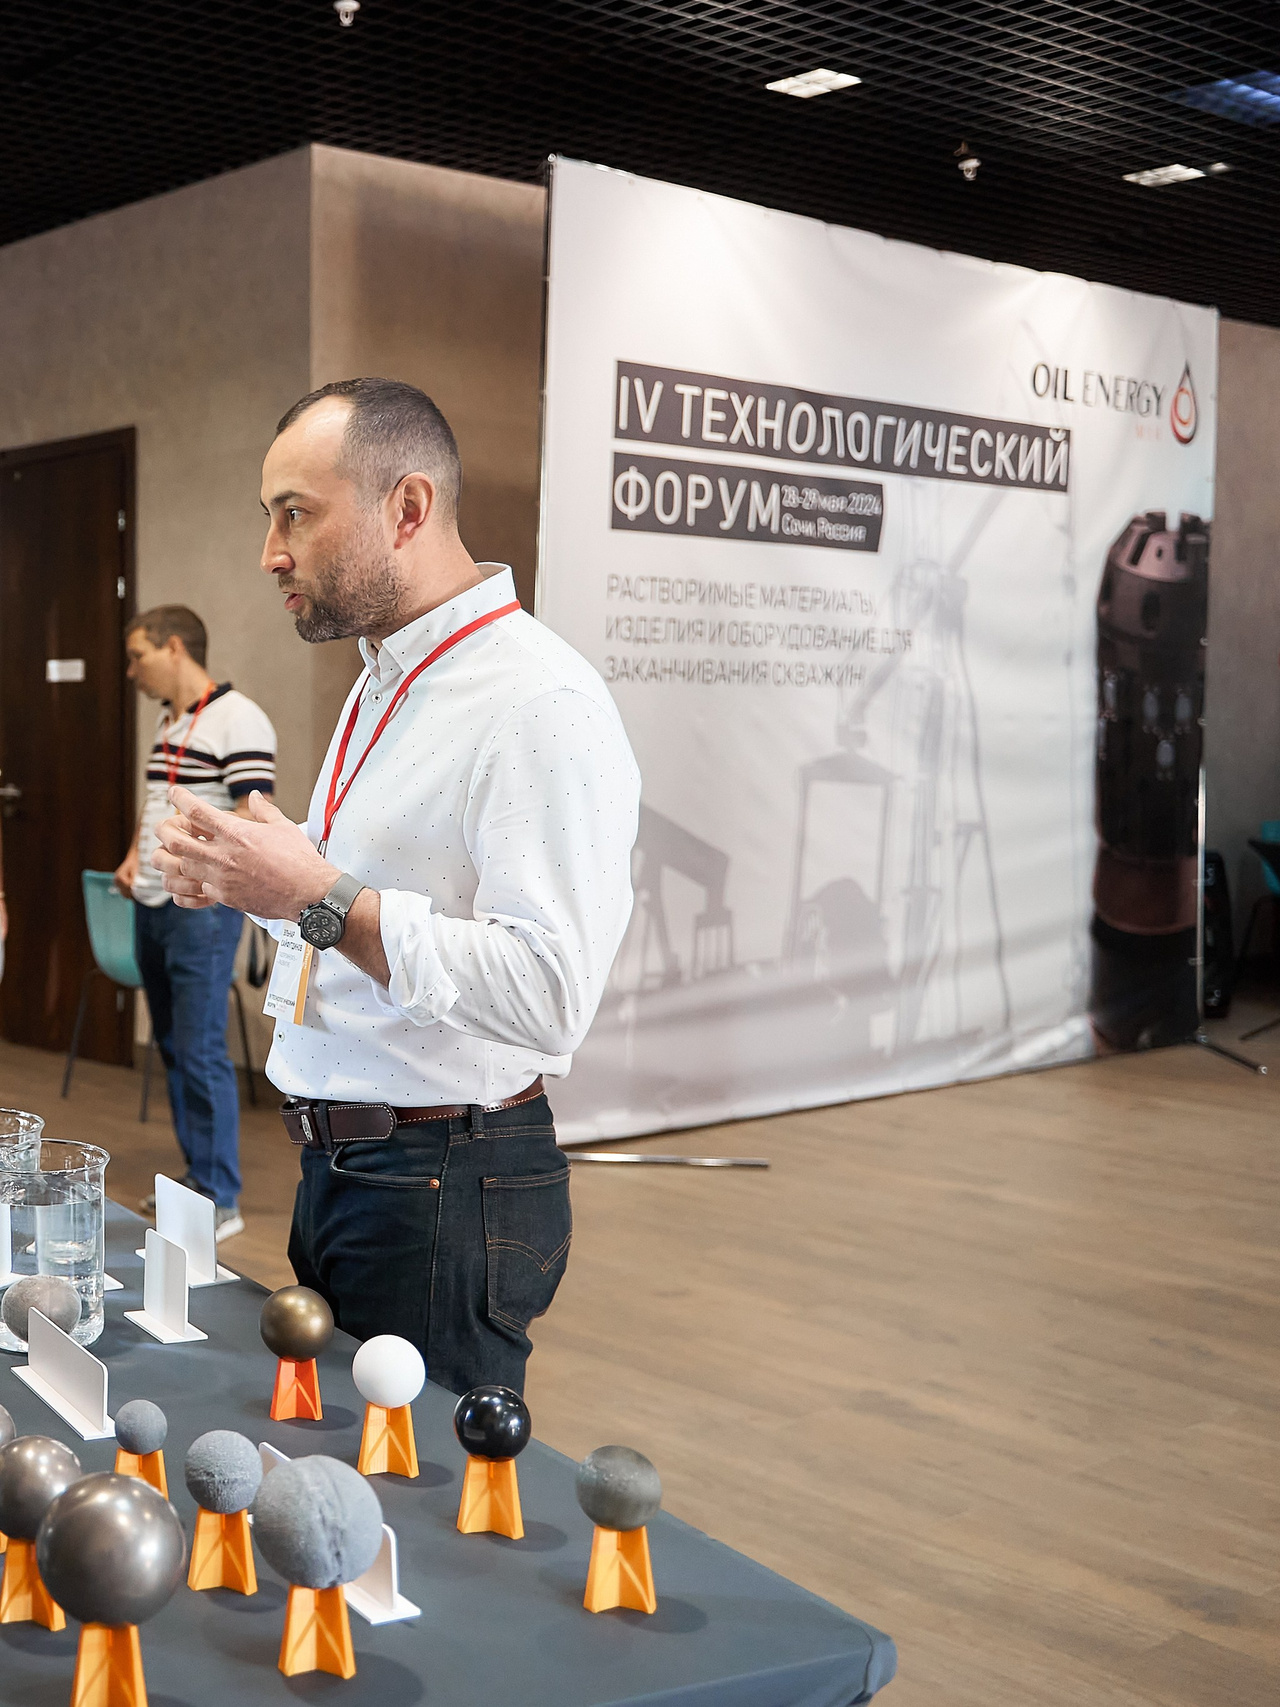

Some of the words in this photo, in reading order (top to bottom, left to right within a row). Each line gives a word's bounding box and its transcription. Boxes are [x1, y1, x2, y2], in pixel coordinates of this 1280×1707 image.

[1032, 363, 1074, 402] OIL
[1081, 370, 1168, 418] ENERGY
[619, 375, 664, 434] IV
[674, 383, 1069, 486] ТЕХНОЛОГИЧЕСКИЙ
[614, 465, 780, 534] ФОРУМ
[846, 492, 882, 516] 2024
[817, 516, 867, 542] Россия
[607, 573, 756, 609] РАСТВОРИМЫЕ
[606, 615, 704, 646] ИЗДЕЛИЯ
[708, 620, 723, 645] И
[726, 620, 876, 653] ОБОРУДОВАНИЕ
[604, 655, 769, 686] ЗАКАНЧИВАНИЯ
[771, 659, 867, 688] СКВАЖИН
